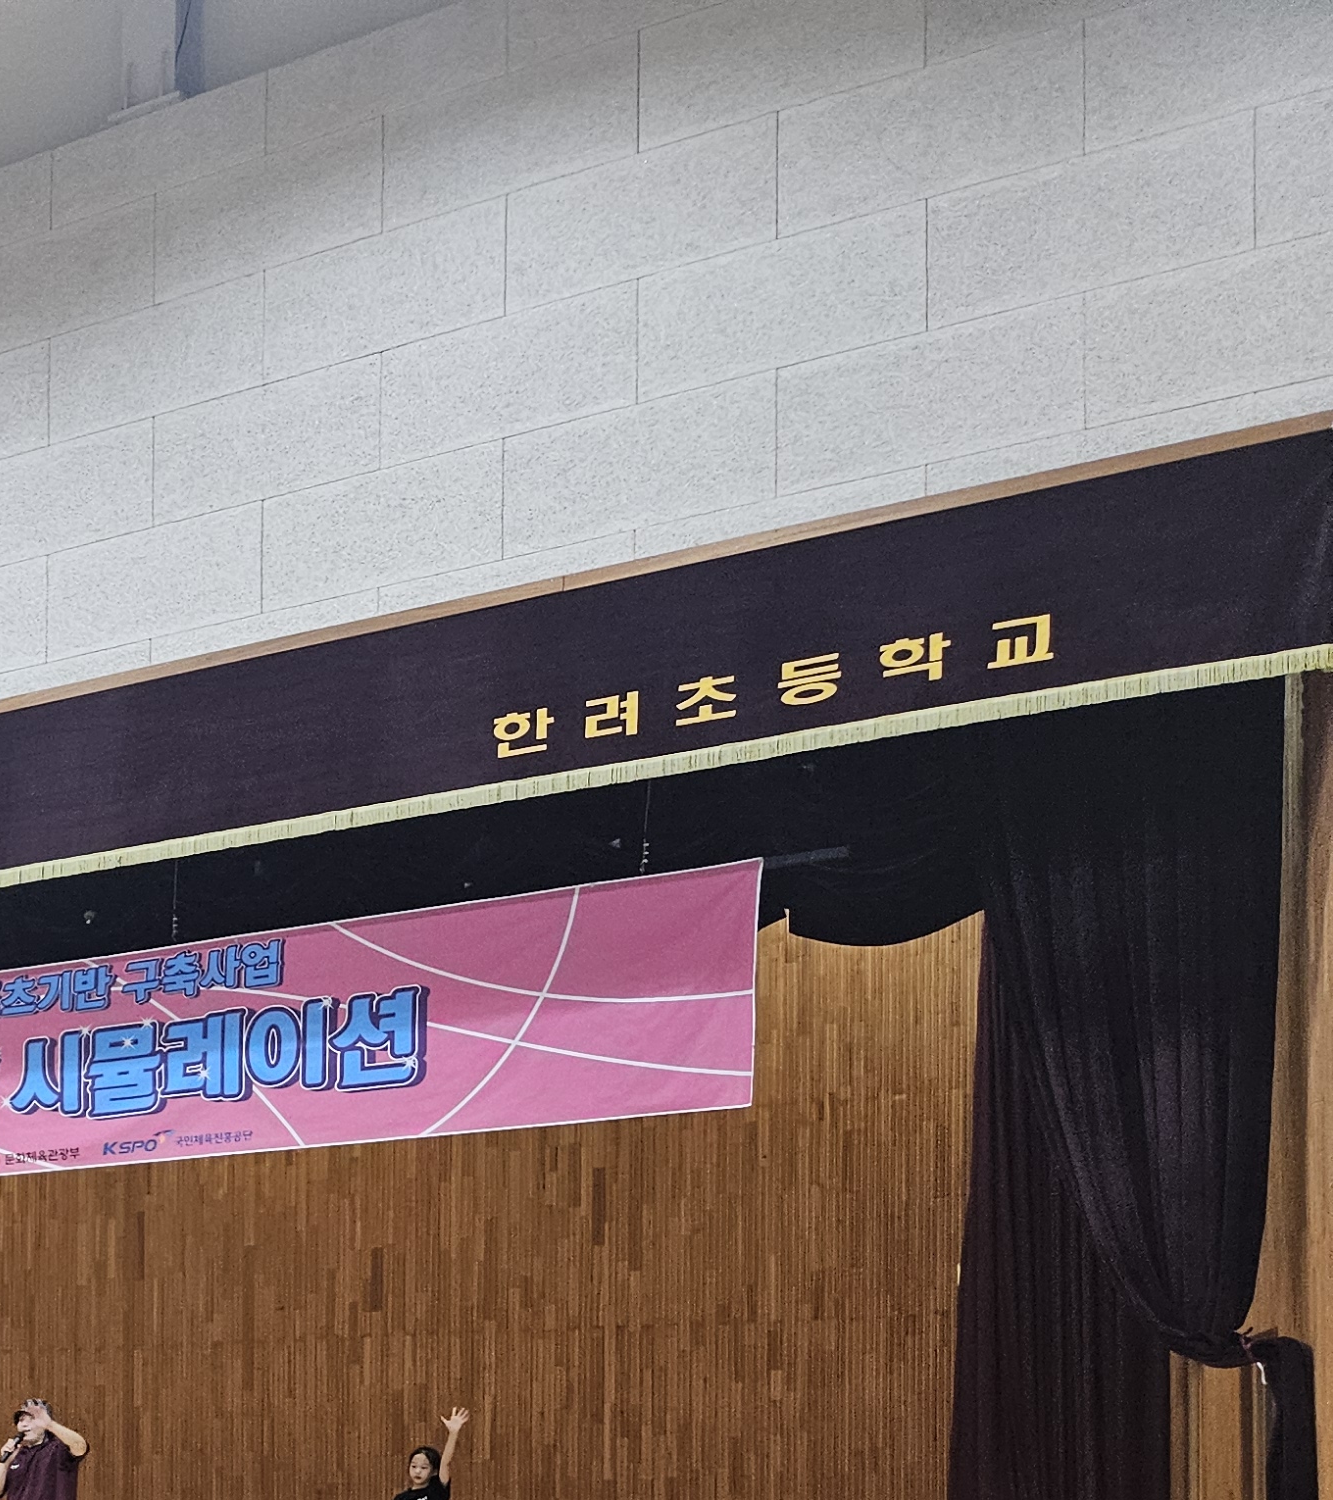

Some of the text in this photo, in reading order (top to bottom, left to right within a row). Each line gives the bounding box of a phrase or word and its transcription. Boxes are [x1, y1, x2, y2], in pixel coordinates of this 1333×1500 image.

[492, 613, 1055, 759] 한려초등학교
[121, 939, 285, 1005] 구축사업
[6, 984, 430, 1120] 시뮬레이션
[5, 1147, 81, 1165] 문화체육관광부
[102, 1139, 158, 1156] KSPO
